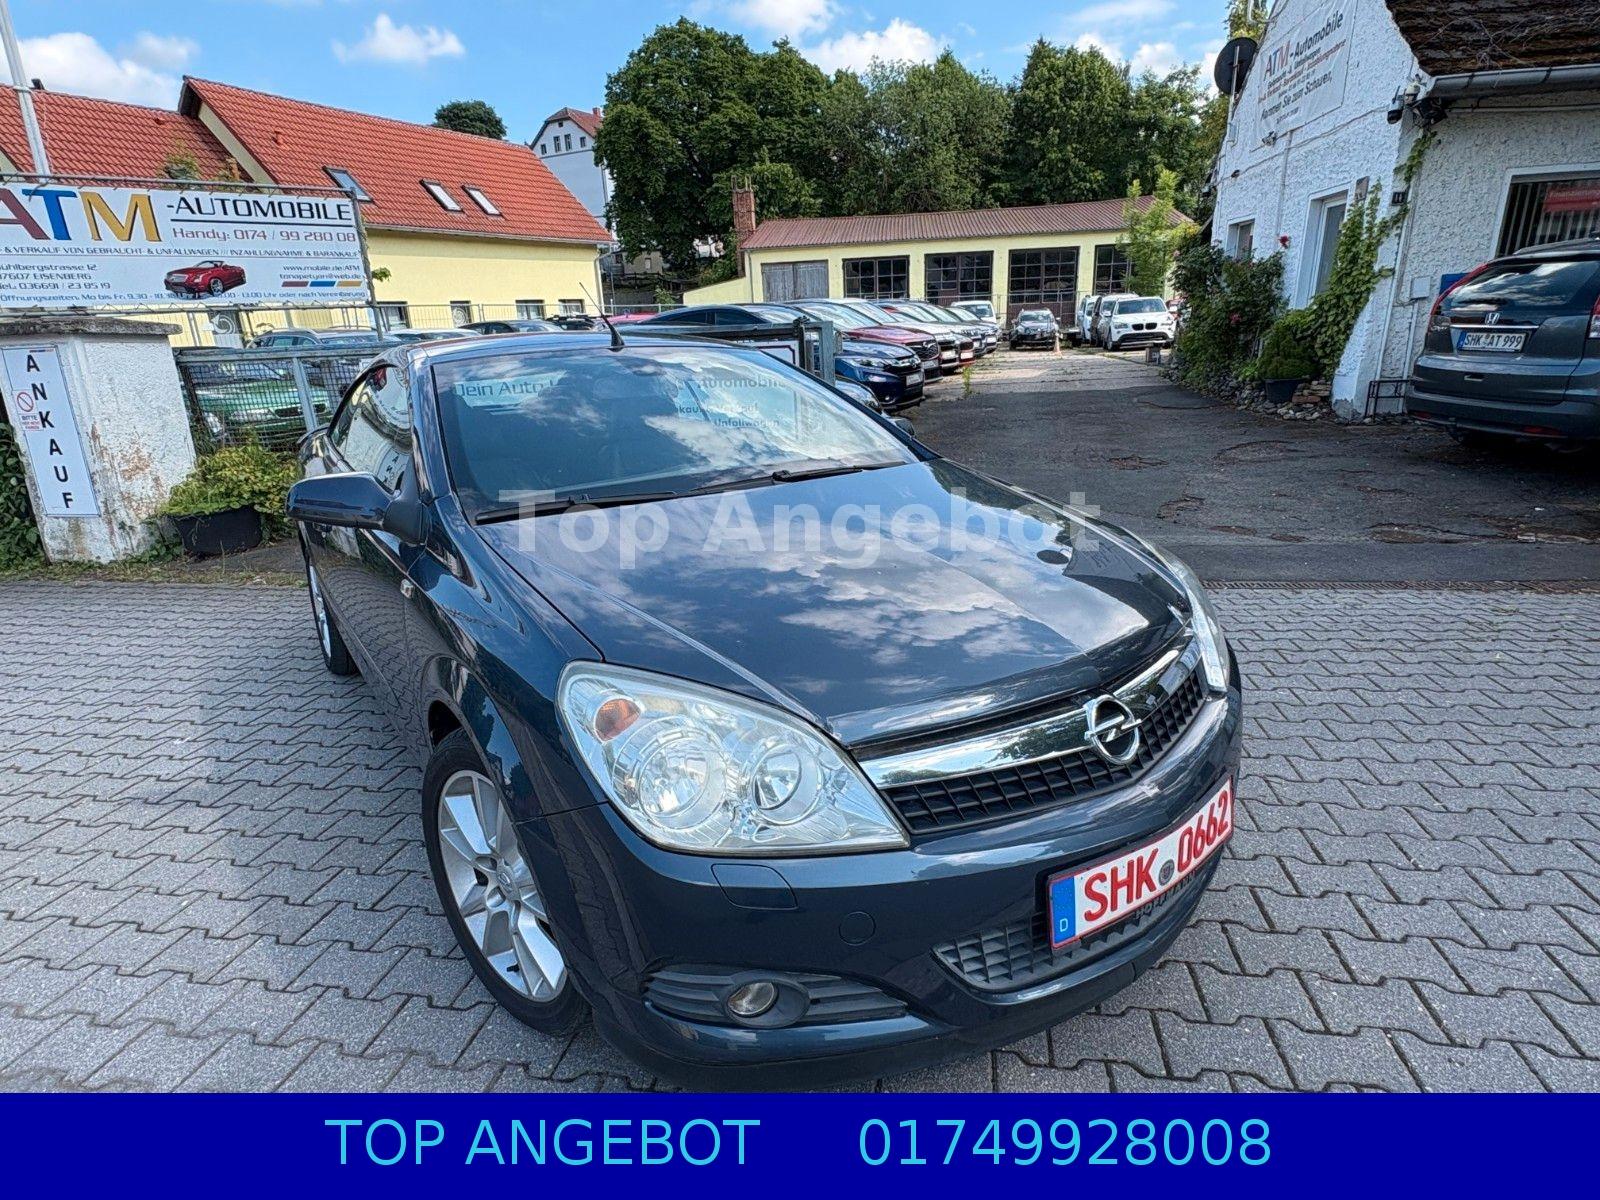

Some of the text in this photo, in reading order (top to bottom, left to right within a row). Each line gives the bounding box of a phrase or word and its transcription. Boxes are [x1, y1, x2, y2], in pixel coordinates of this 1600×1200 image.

[173, 228, 230, 242] Handy:
[234, 229, 267, 240] 0174
[280, 231, 300, 241] 99
[304, 232, 333, 241] 280
[337, 232, 356, 242] 08
[13, 246, 60, 254] VERKAUF
[0, 263, 84, 272] ühlbergstrasse
[19, 282, 59, 290] 036691
[1502, 335, 1523, 348] 999
[1084, 790, 1230, 922] SHK 0662
